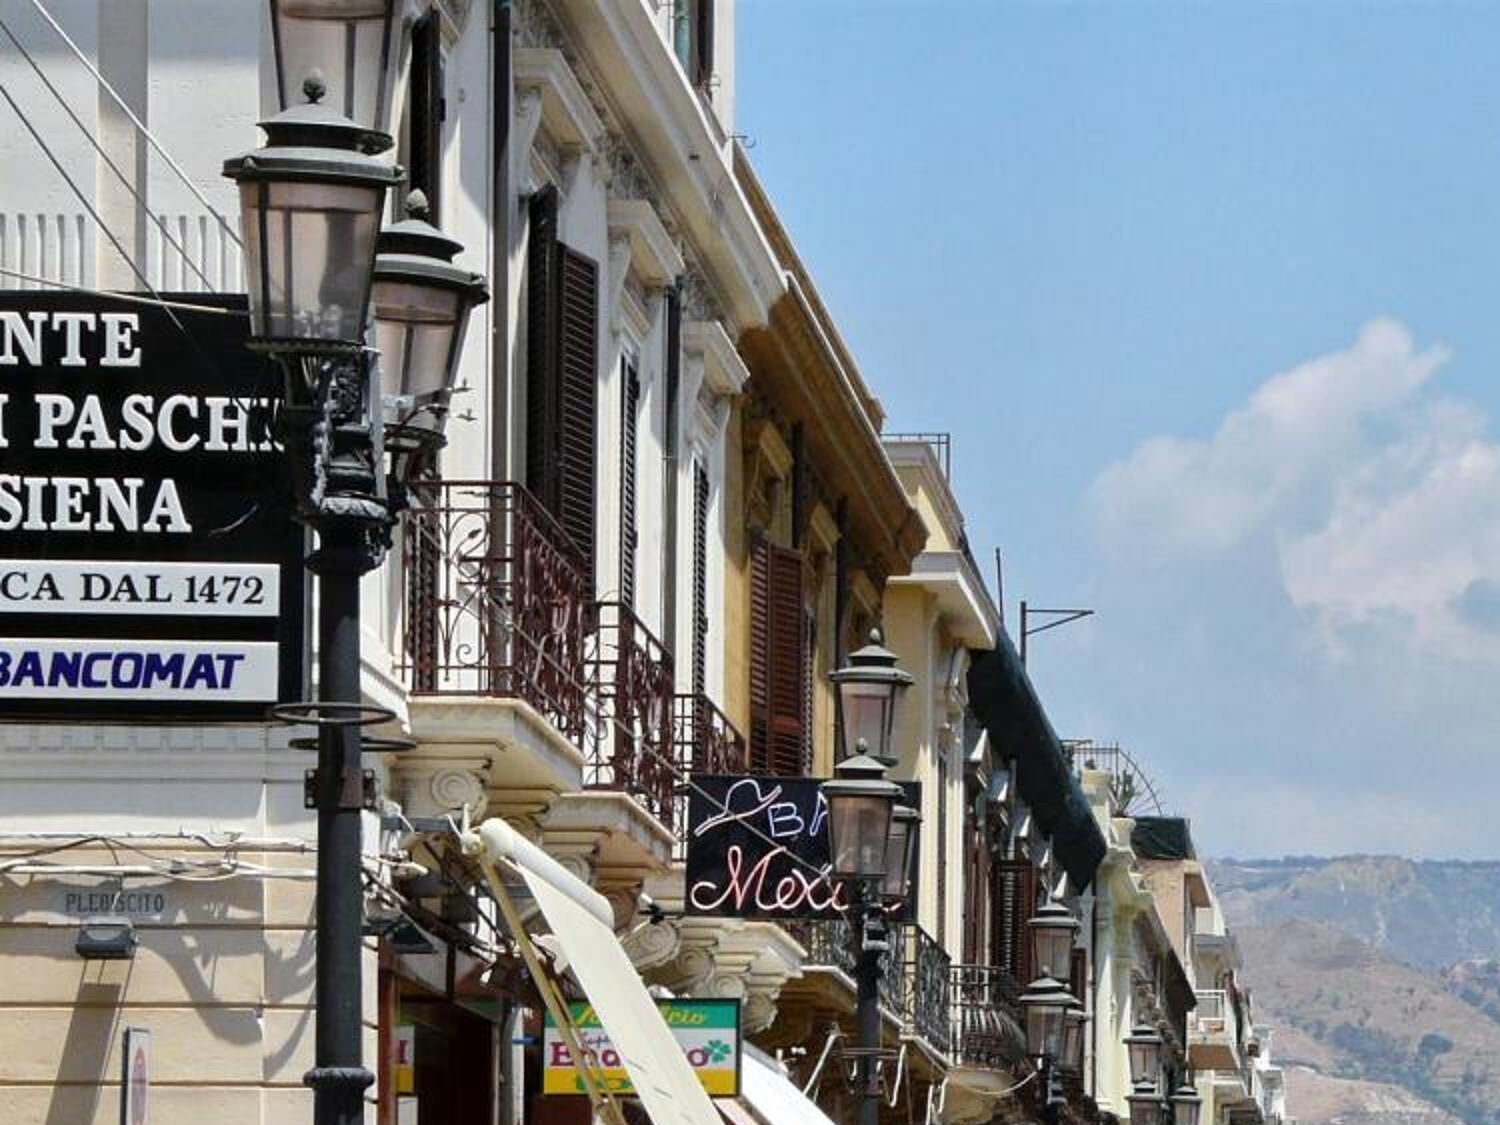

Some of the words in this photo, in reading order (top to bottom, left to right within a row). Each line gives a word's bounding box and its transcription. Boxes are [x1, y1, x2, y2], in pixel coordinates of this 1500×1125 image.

[0, 473, 193, 533] SIENA
[80, 573, 173, 603] DAL
[184, 575, 265, 605] 1472
